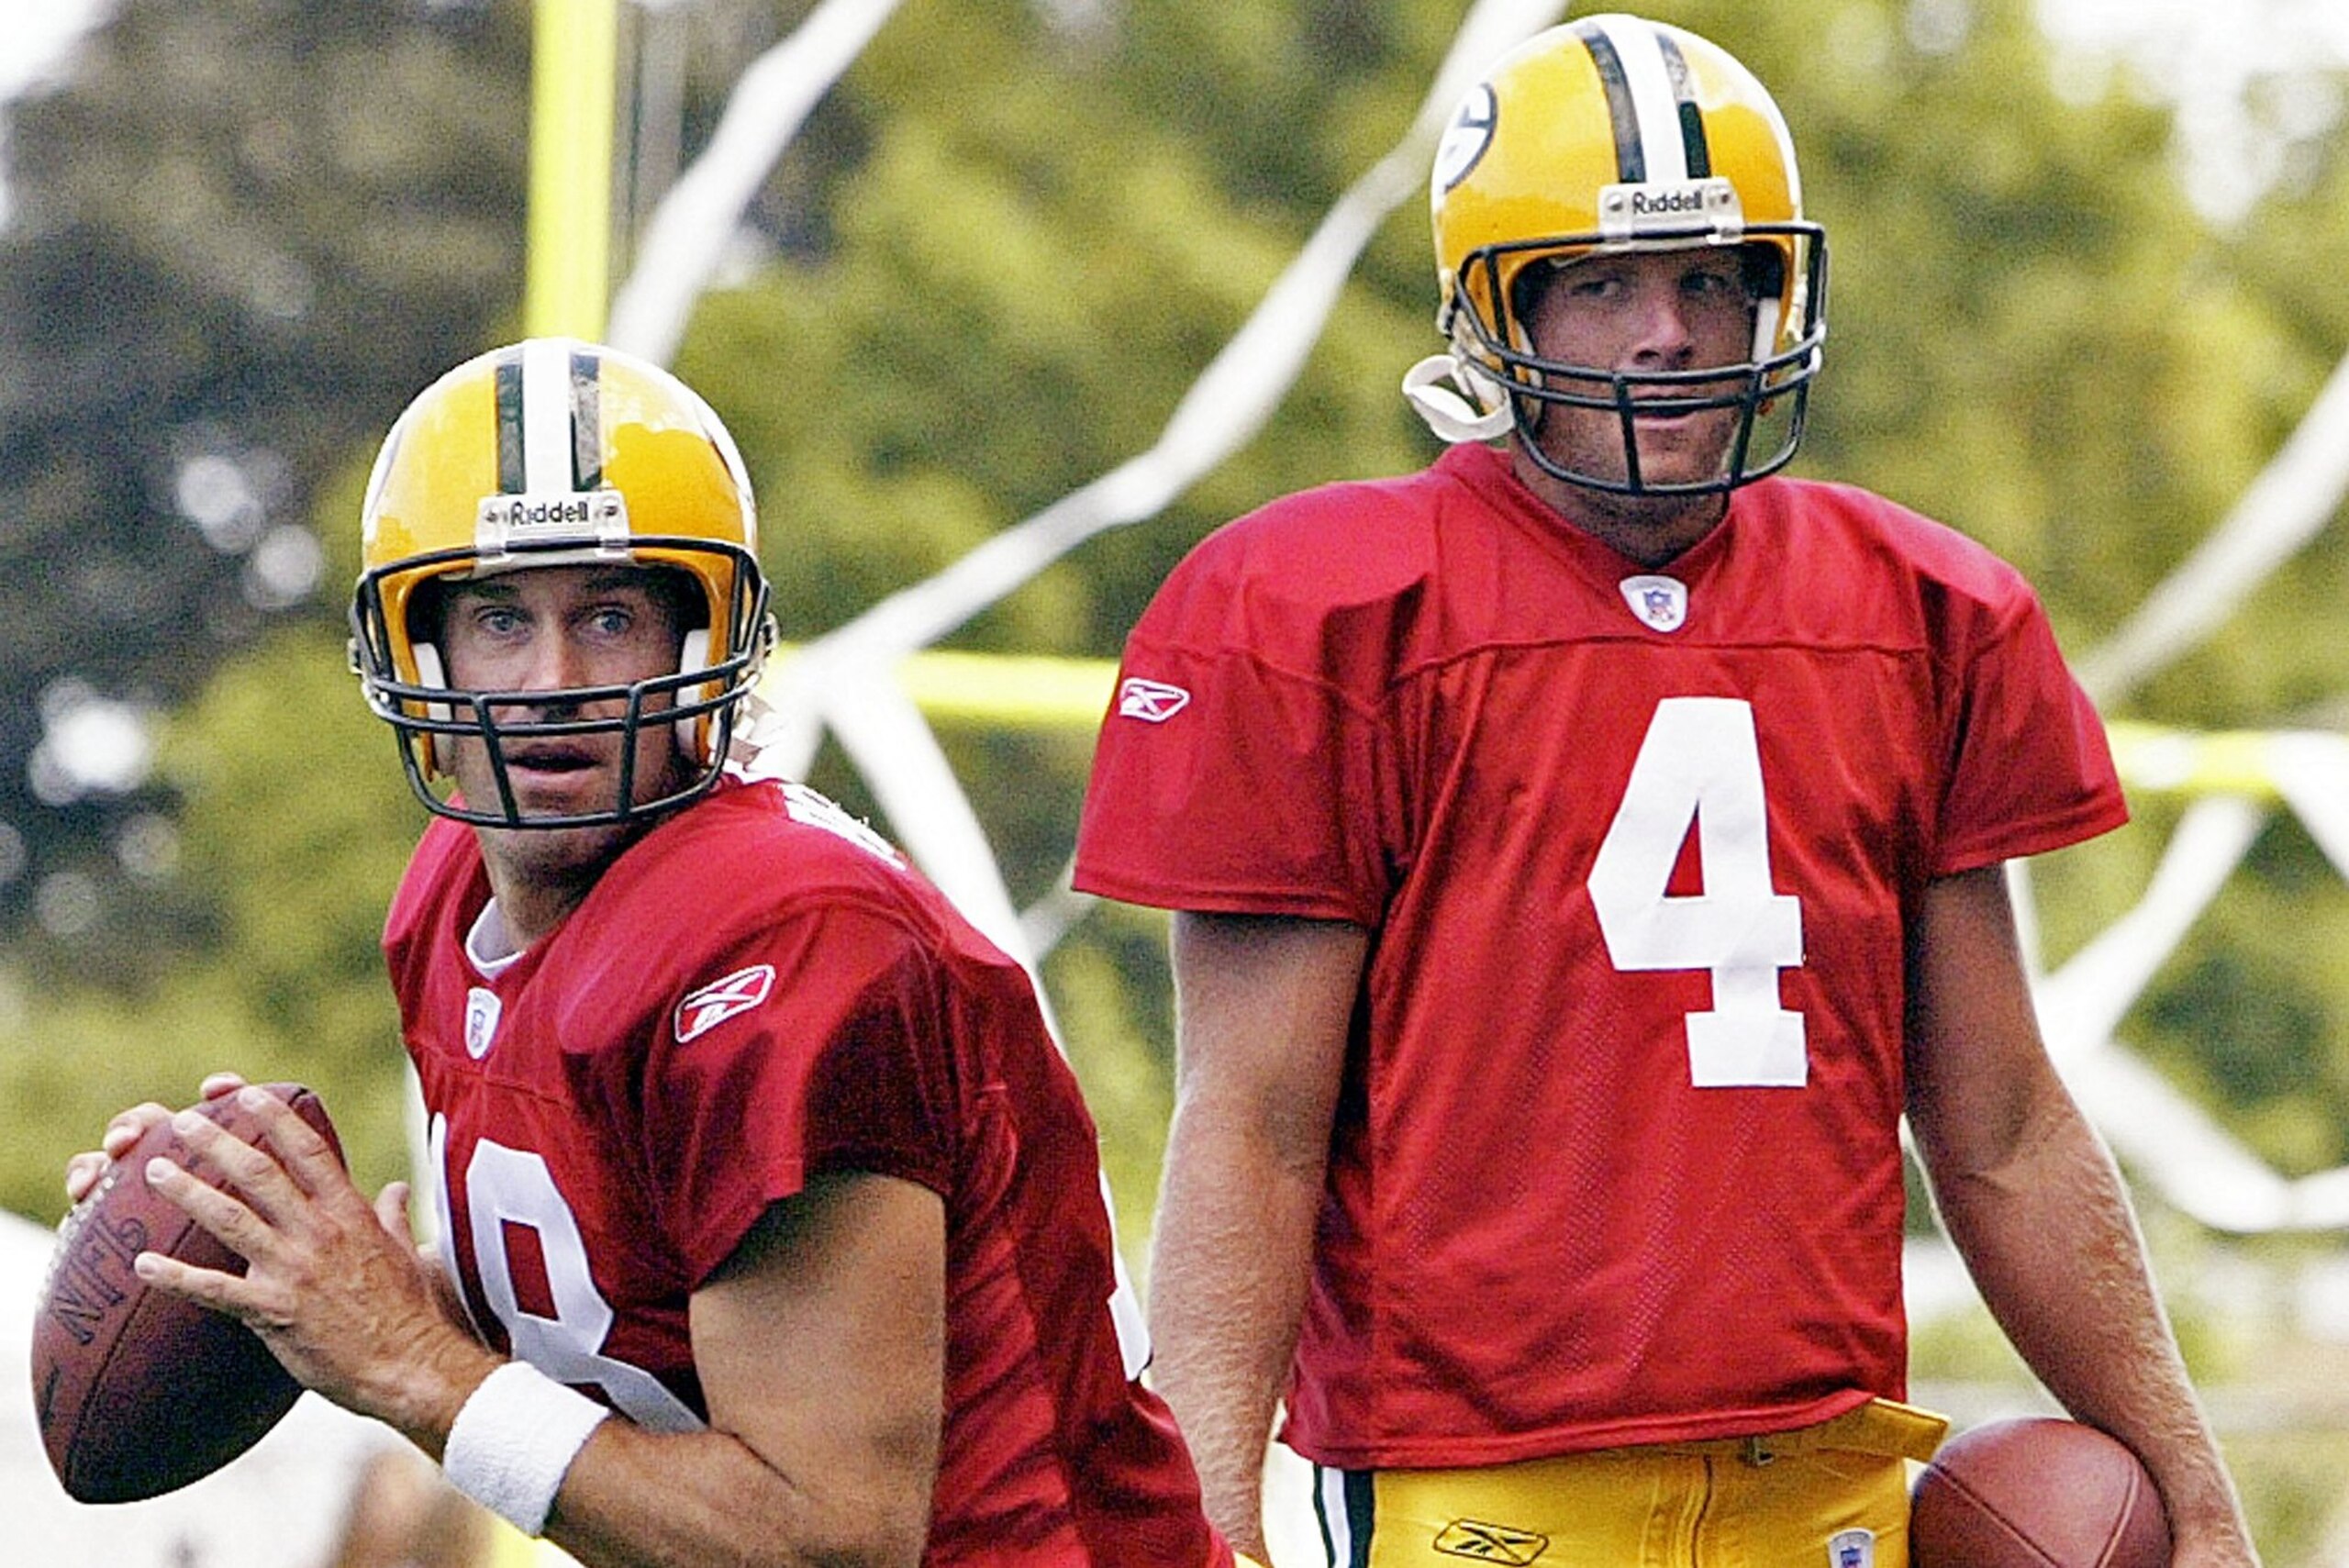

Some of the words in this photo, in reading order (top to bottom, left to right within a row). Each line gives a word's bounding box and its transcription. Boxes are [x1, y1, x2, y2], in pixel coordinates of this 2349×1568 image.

[1632, 190, 1703, 215] Riddell
[510, 500, 589, 526] Riddell
[1586, 696, 1809, 1087] 4
